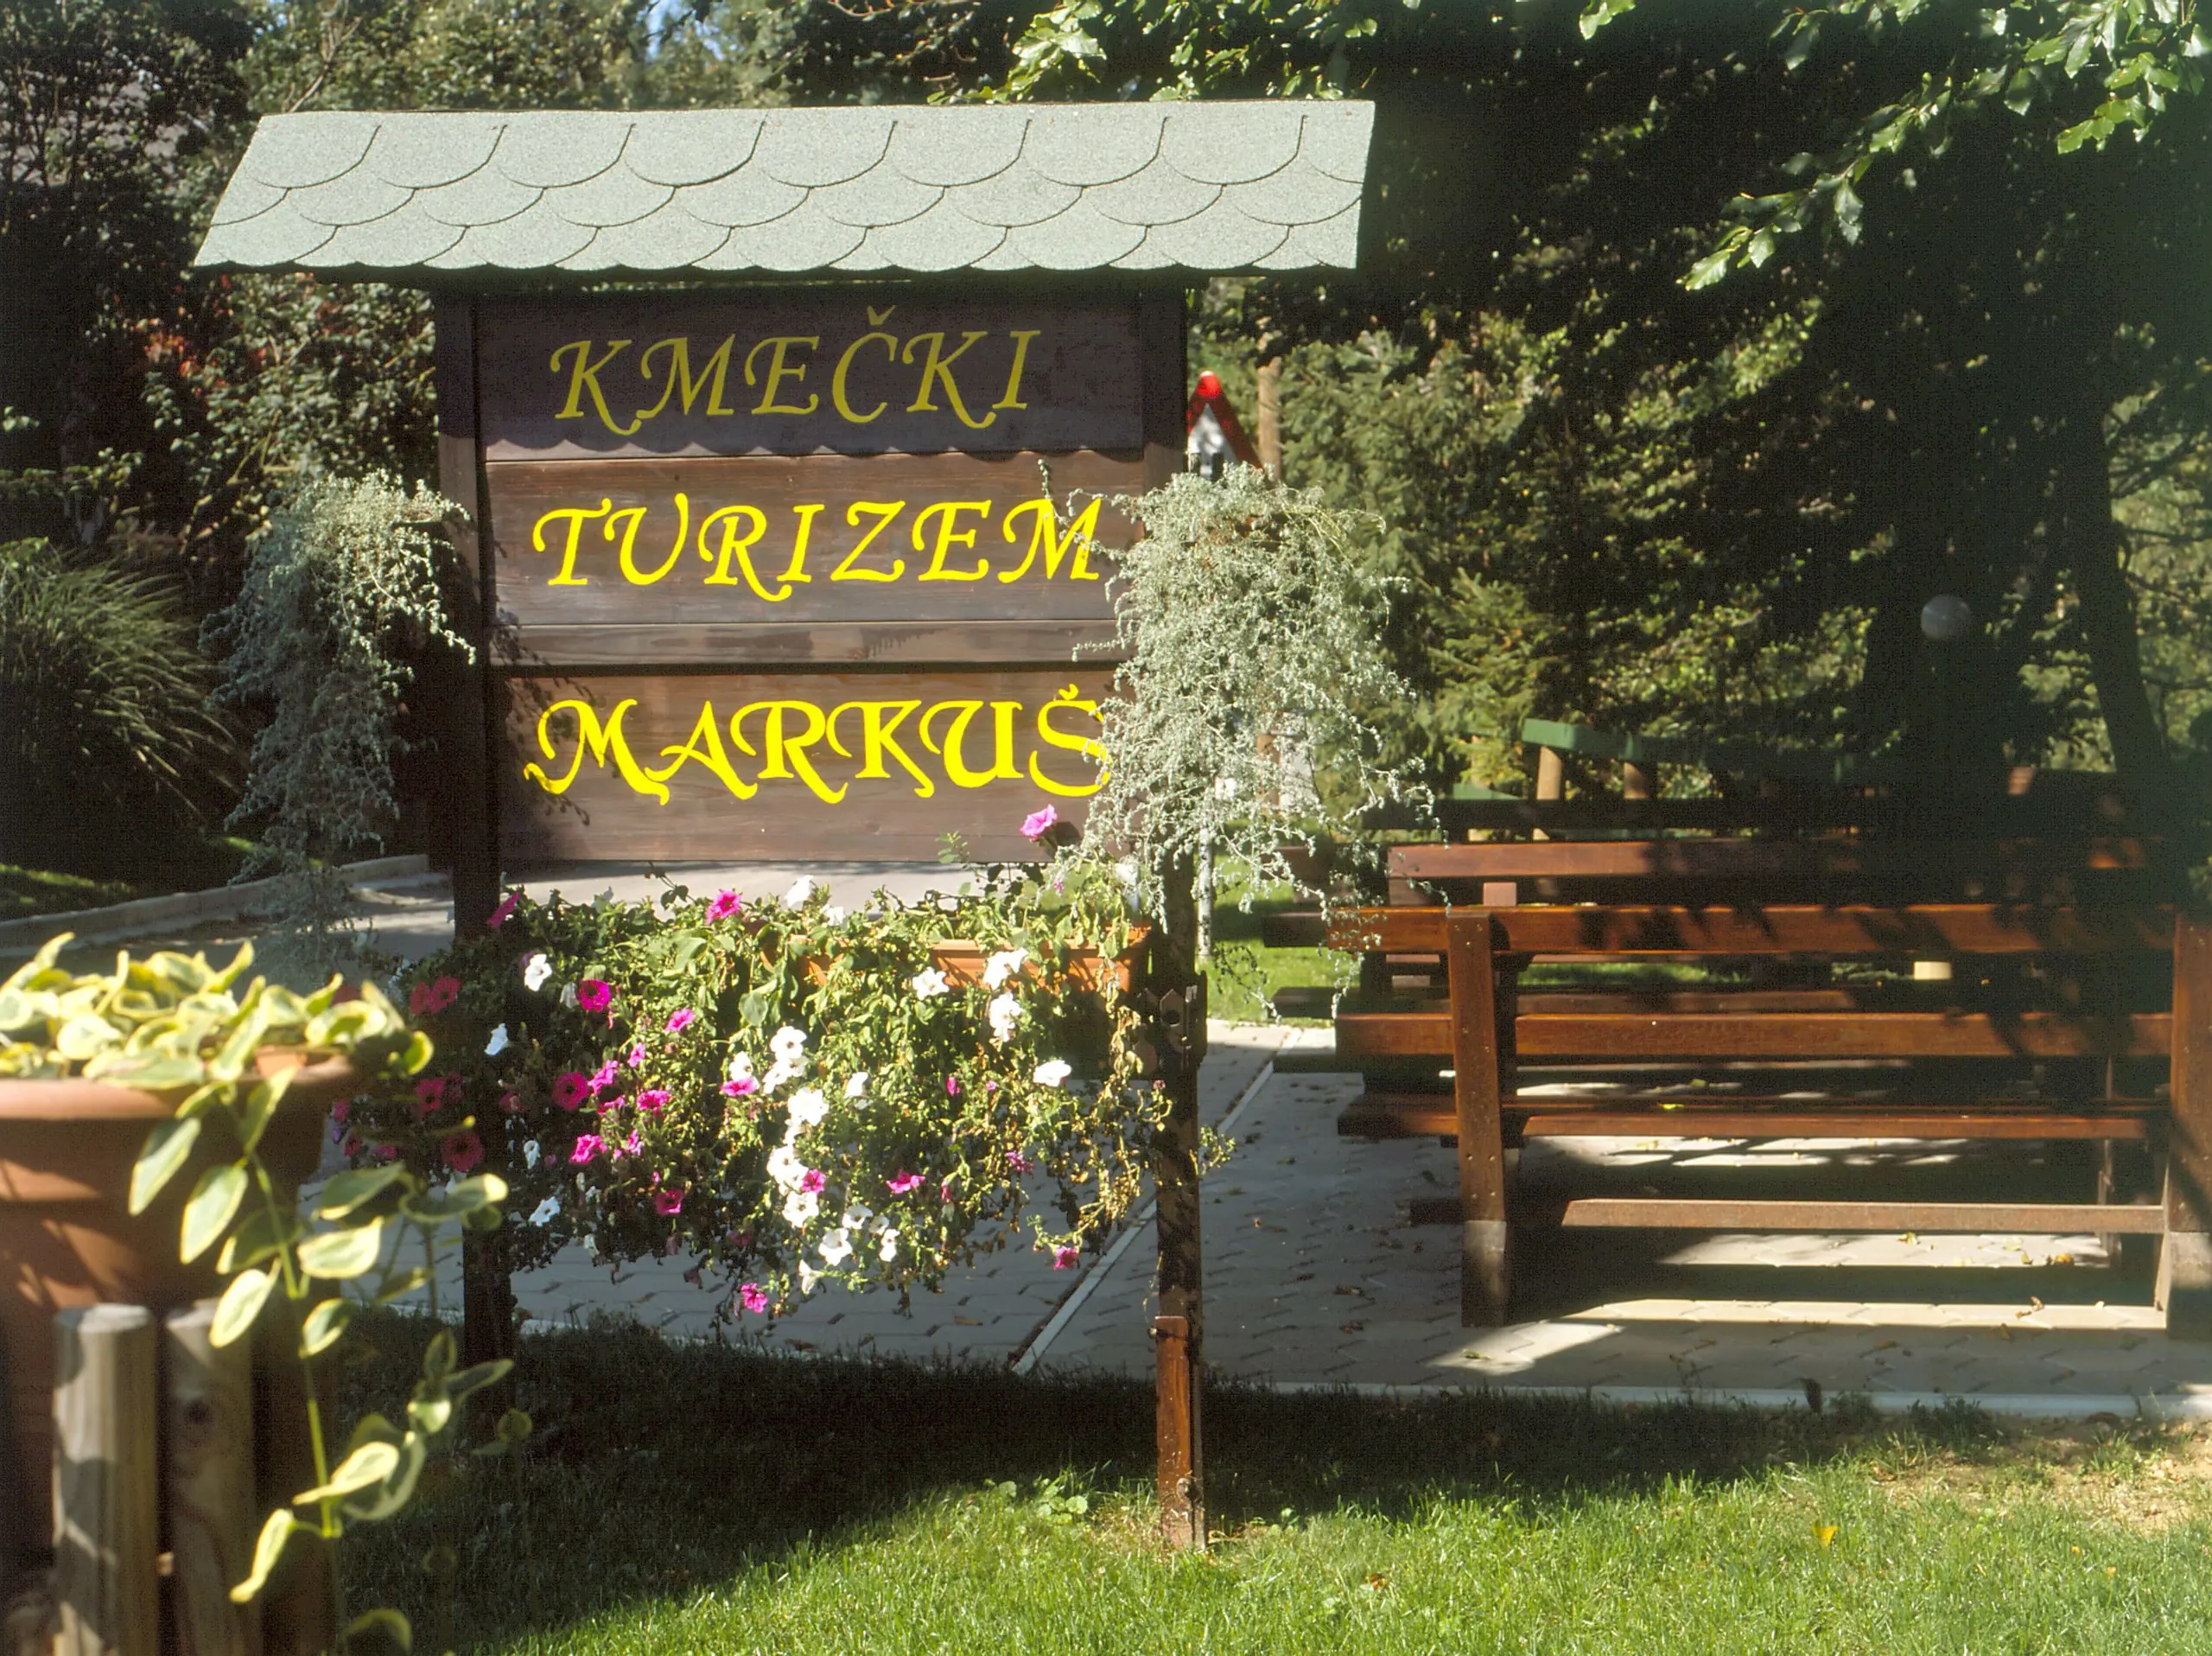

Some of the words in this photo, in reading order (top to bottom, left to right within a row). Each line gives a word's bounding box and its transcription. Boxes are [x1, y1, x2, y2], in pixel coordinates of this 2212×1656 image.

[550, 306, 1040, 435] KMEČKI
[532, 493, 1103, 602] TURIZEM
[523, 683, 1113, 806] MARKUŠ
